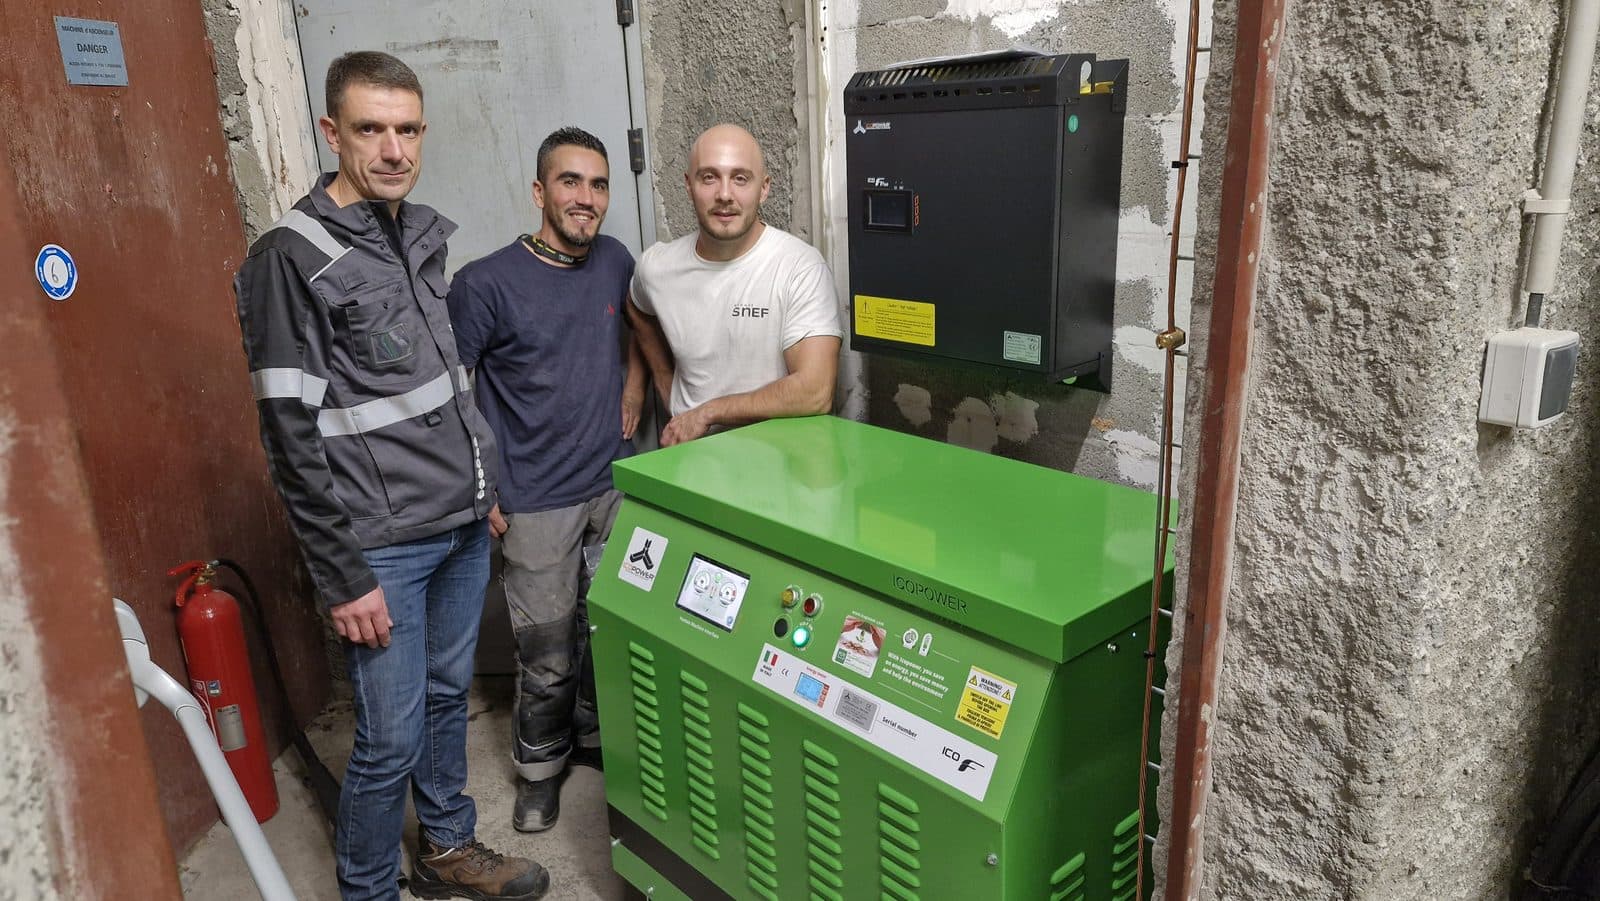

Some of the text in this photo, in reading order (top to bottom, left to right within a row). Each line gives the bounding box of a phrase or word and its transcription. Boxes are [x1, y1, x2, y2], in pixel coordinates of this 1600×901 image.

[77, 43, 109, 54] DANGER
[51, 262, 59, 283] 6
[891, 575, 969, 615] ICOPOWER
[888, 652, 899, 661] With
[922, 667, 932, 676] you
[933, 672, 945, 681] save
[892, 663, 909, 675] energy,
[909, 671, 920, 679] you
[920, 675, 931, 684] save
[931, 681, 949, 692] money
[892, 671, 903, 680] help
[903, 676, 912, 684] the
[912, 681, 944, 699] environment
[981, 677, 1003, 690] WARNING!
[882, 716, 918, 738] Serial number
[942, 746, 961, 762] ICO
